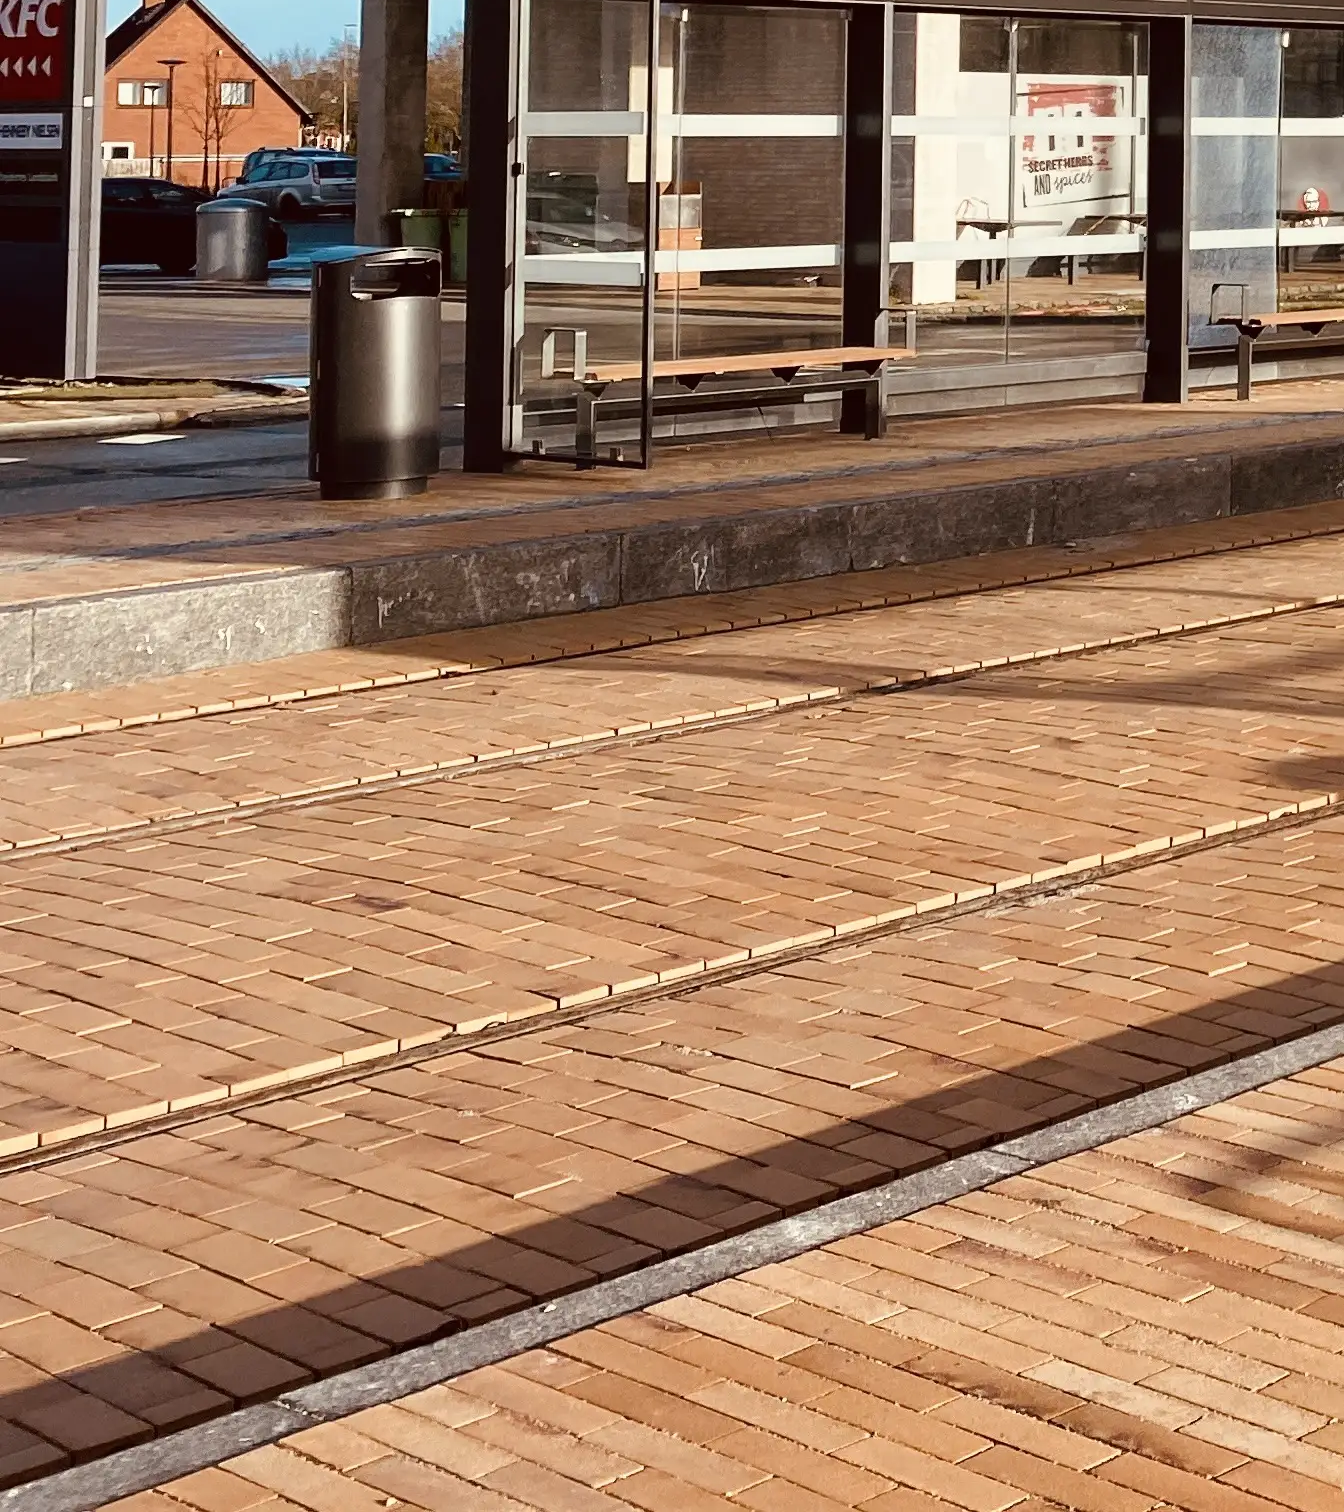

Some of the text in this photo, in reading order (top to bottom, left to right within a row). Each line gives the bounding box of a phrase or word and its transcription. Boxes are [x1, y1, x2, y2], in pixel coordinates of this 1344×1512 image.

[1028, 155, 1094, 173] SECRET HERBS
[1034, 170, 1094, 196] AND spices
